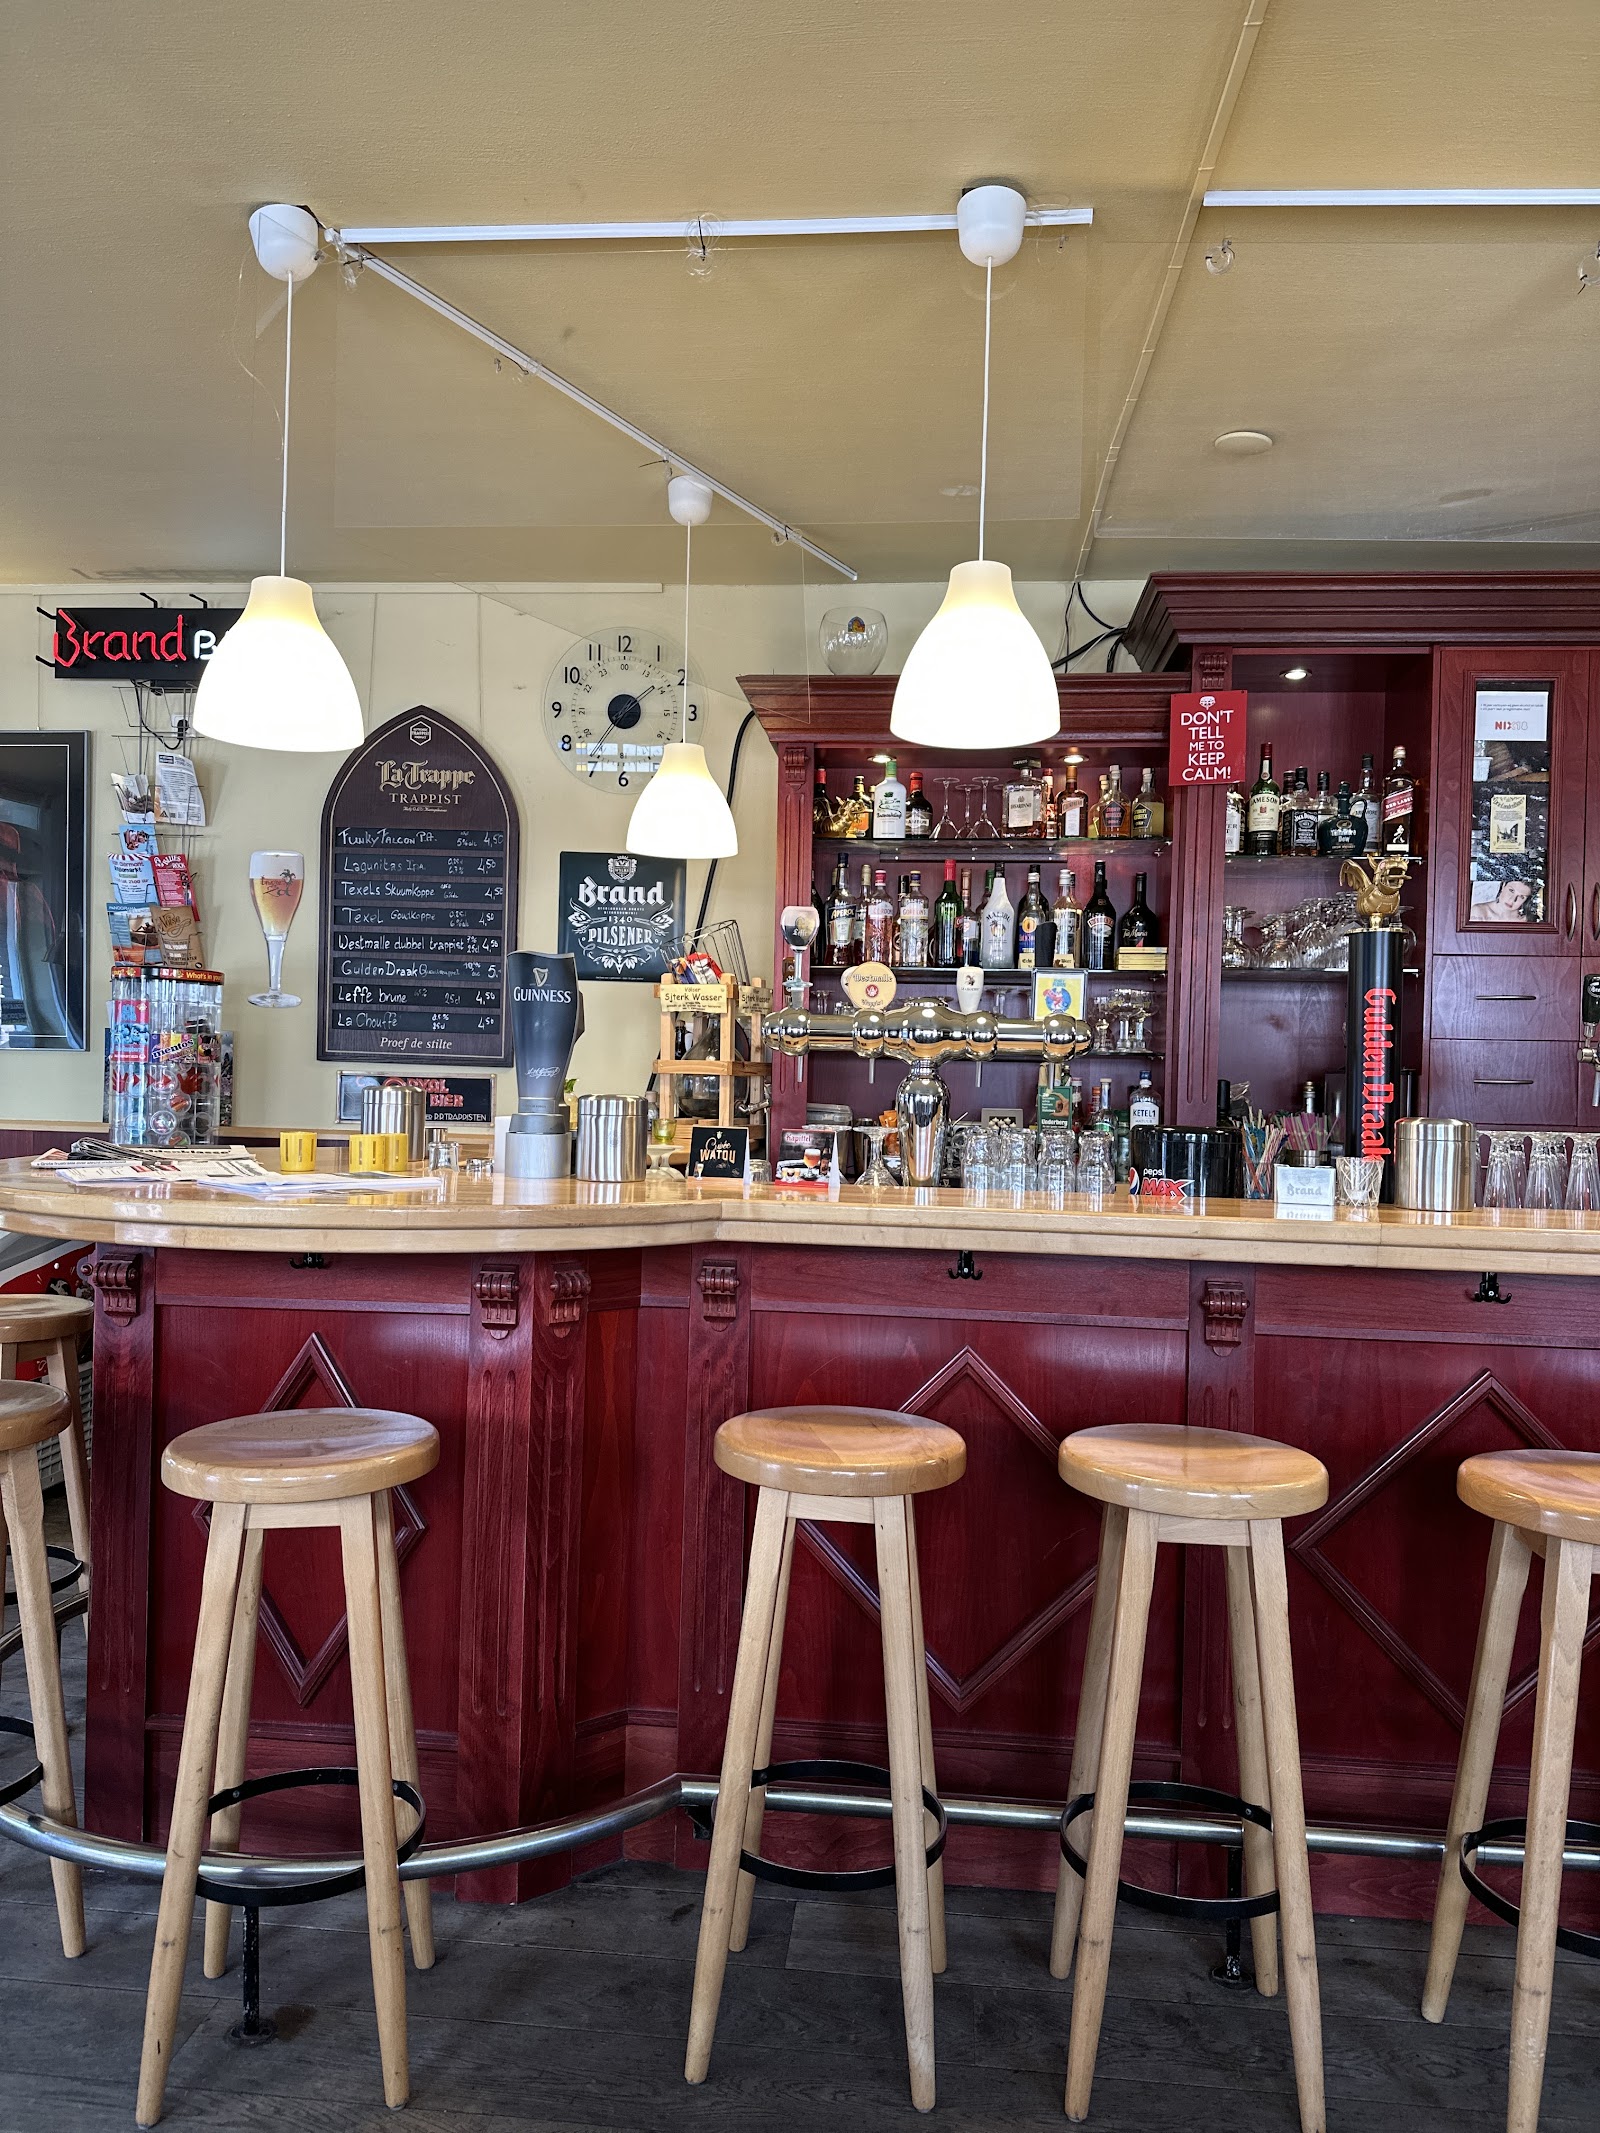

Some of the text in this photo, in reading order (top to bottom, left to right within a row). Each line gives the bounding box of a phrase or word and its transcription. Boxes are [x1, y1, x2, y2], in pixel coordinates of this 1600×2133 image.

[53, 609, 187, 668] Brand
[618, 635, 632, 653] 12
[589, 644, 601, 661] 11
[656, 645, 661, 662] 1
[564, 667, 580, 684] 10
[551, 701, 563, 719] 9
[687, 704, 698, 722] 3
[1180, 709, 1234, 726] DON'T
[1188, 725, 1225, 740] TELL
[561, 734, 572, 752] 8
[1189, 740, 1225, 752] ME TO
[1188, 752, 1225, 767] KEEP
[587, 760, 598, 778] 7
[1182, 766, 1231, 782] CALM!
[618, 771, 629, 787] 6
[389, 792, 462, 805] TRAPPIST
[343, 856, 403, 875] Lagunitas
[578, 875, 667, 908] Brand
[608, 915, 633, 925] 1340
[831, 908, 854, 919] APEROL
[338, 934, 465, 954] Westmalle dubbel trappist
[587, 925, 653, 947] PILSENER
[341, 959, 385, 977] Gulden
[385, 960, 419, 977] Draak
[853, 974, 893, 983] Westmalle
[338, 985, 408, 1004] Leffe brune
[513, 985, 572, 1004] GUINNESS
[692, 993, 723, 1002] Wasser
[337, 1013, 353, 1027] La
[151, 1039, 195, 1060] mentos
[380, 1036, 453, 1050] Proef de stilte
[1361, 988, 1397, 1163] Gulden Draak
[429, 1094, 464, 1108] BIER
[1132, 1108, 1157, 1118] KETEL1
[1041, 1118, 1068, 1127] Underberg
[785, 1133, 812, 1144] Kapittel
[700, 1148, 736, 1164] WATOU
[1143, 1168, 1164, 1177] pepsi
[1141, 1178, 1195, 1199] MAX
[1286, 1183, 1323, 1197] Brand
